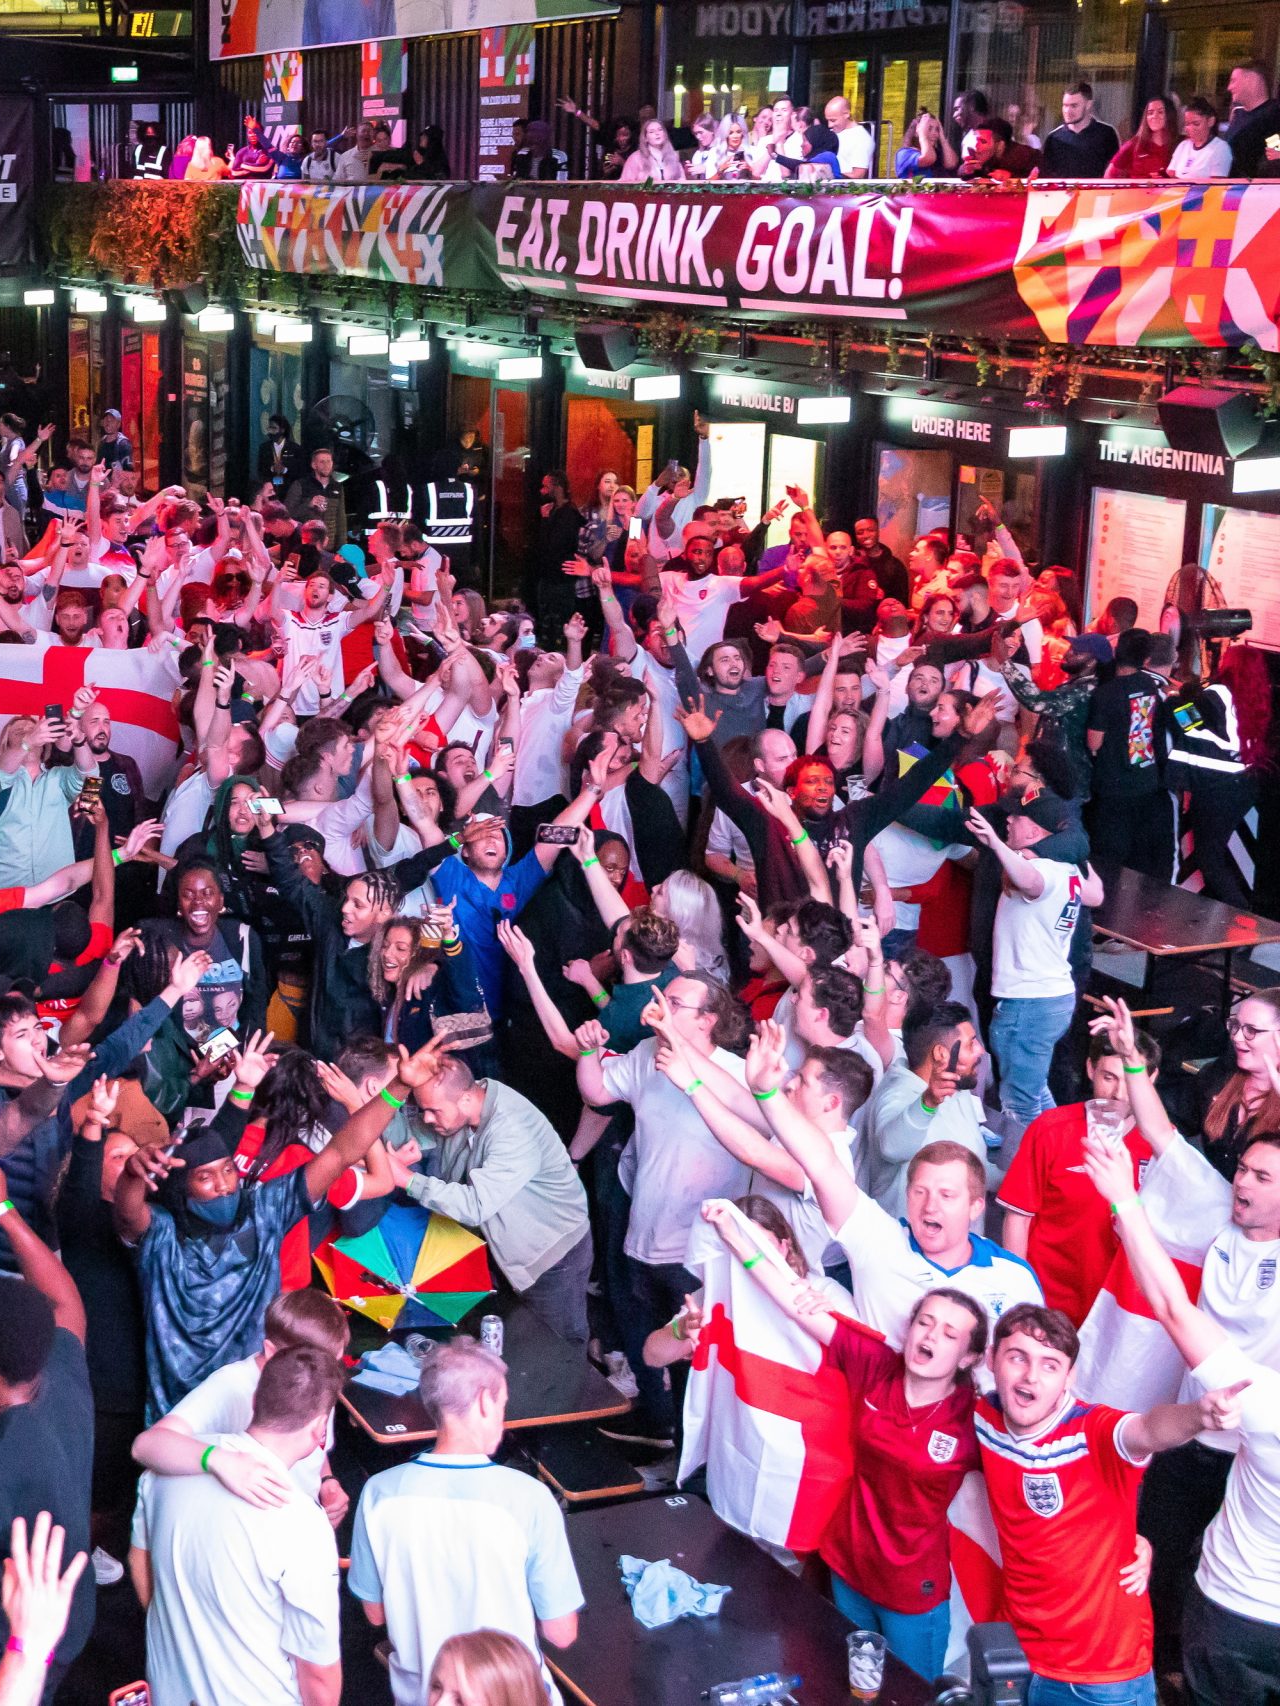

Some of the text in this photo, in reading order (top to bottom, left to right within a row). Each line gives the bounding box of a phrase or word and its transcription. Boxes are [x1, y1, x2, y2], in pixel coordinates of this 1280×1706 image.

[495, 195, 914, 300] EAT. DRINK. GOAL!
[721, 391, 739, 406] THE
[741, 393, 781, 412] NOODLE
[911, 414, 992, 443] ORDER HERE
[1098, 439, 1225, 476] THE ARGENTINIA
[664, 1496, 689, 1507] 03
